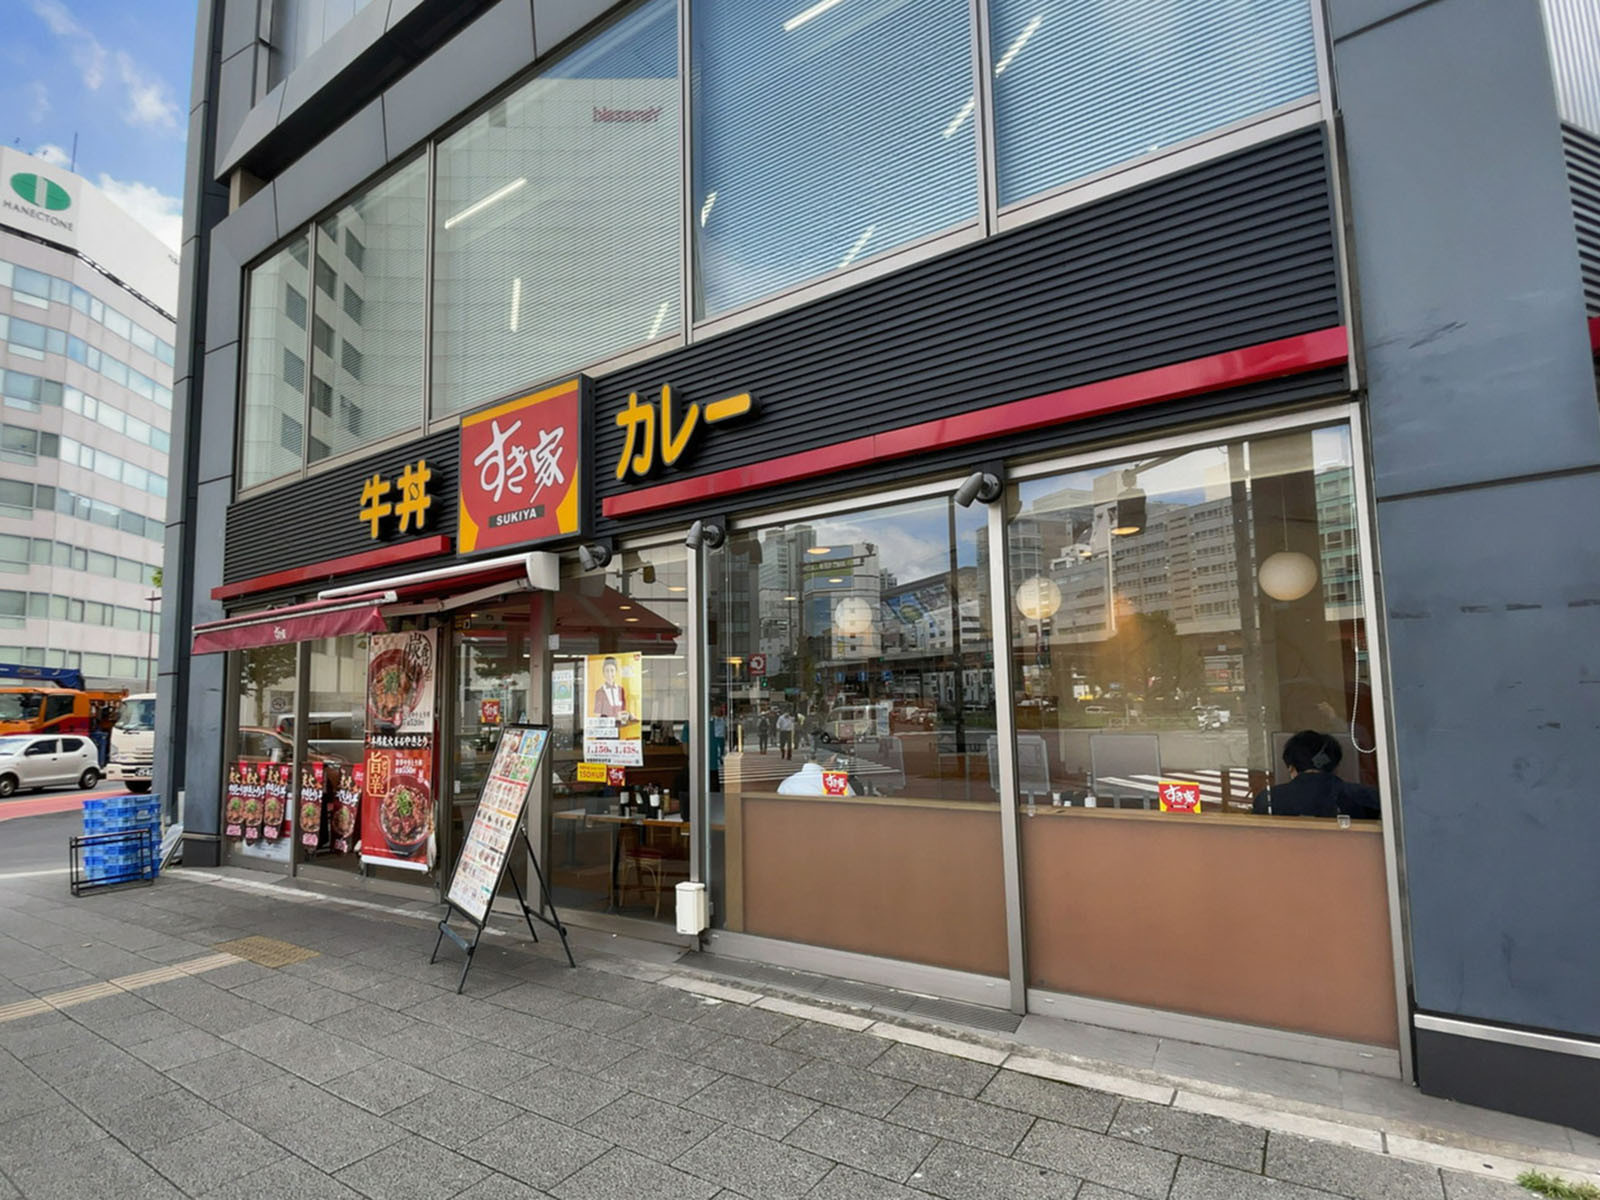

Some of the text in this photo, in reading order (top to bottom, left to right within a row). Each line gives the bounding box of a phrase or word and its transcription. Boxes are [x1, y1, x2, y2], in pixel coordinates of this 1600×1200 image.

[3, 200, 73, 231] HANECTONE
[616, 383, 752, 481] カレー
[474, 420, 565, 503] すき家
[360, 459, 432, 539] 牛丼
[496, 508, 537, 526] SUKIYA
[1163, 784, 1196, 804] すき家
